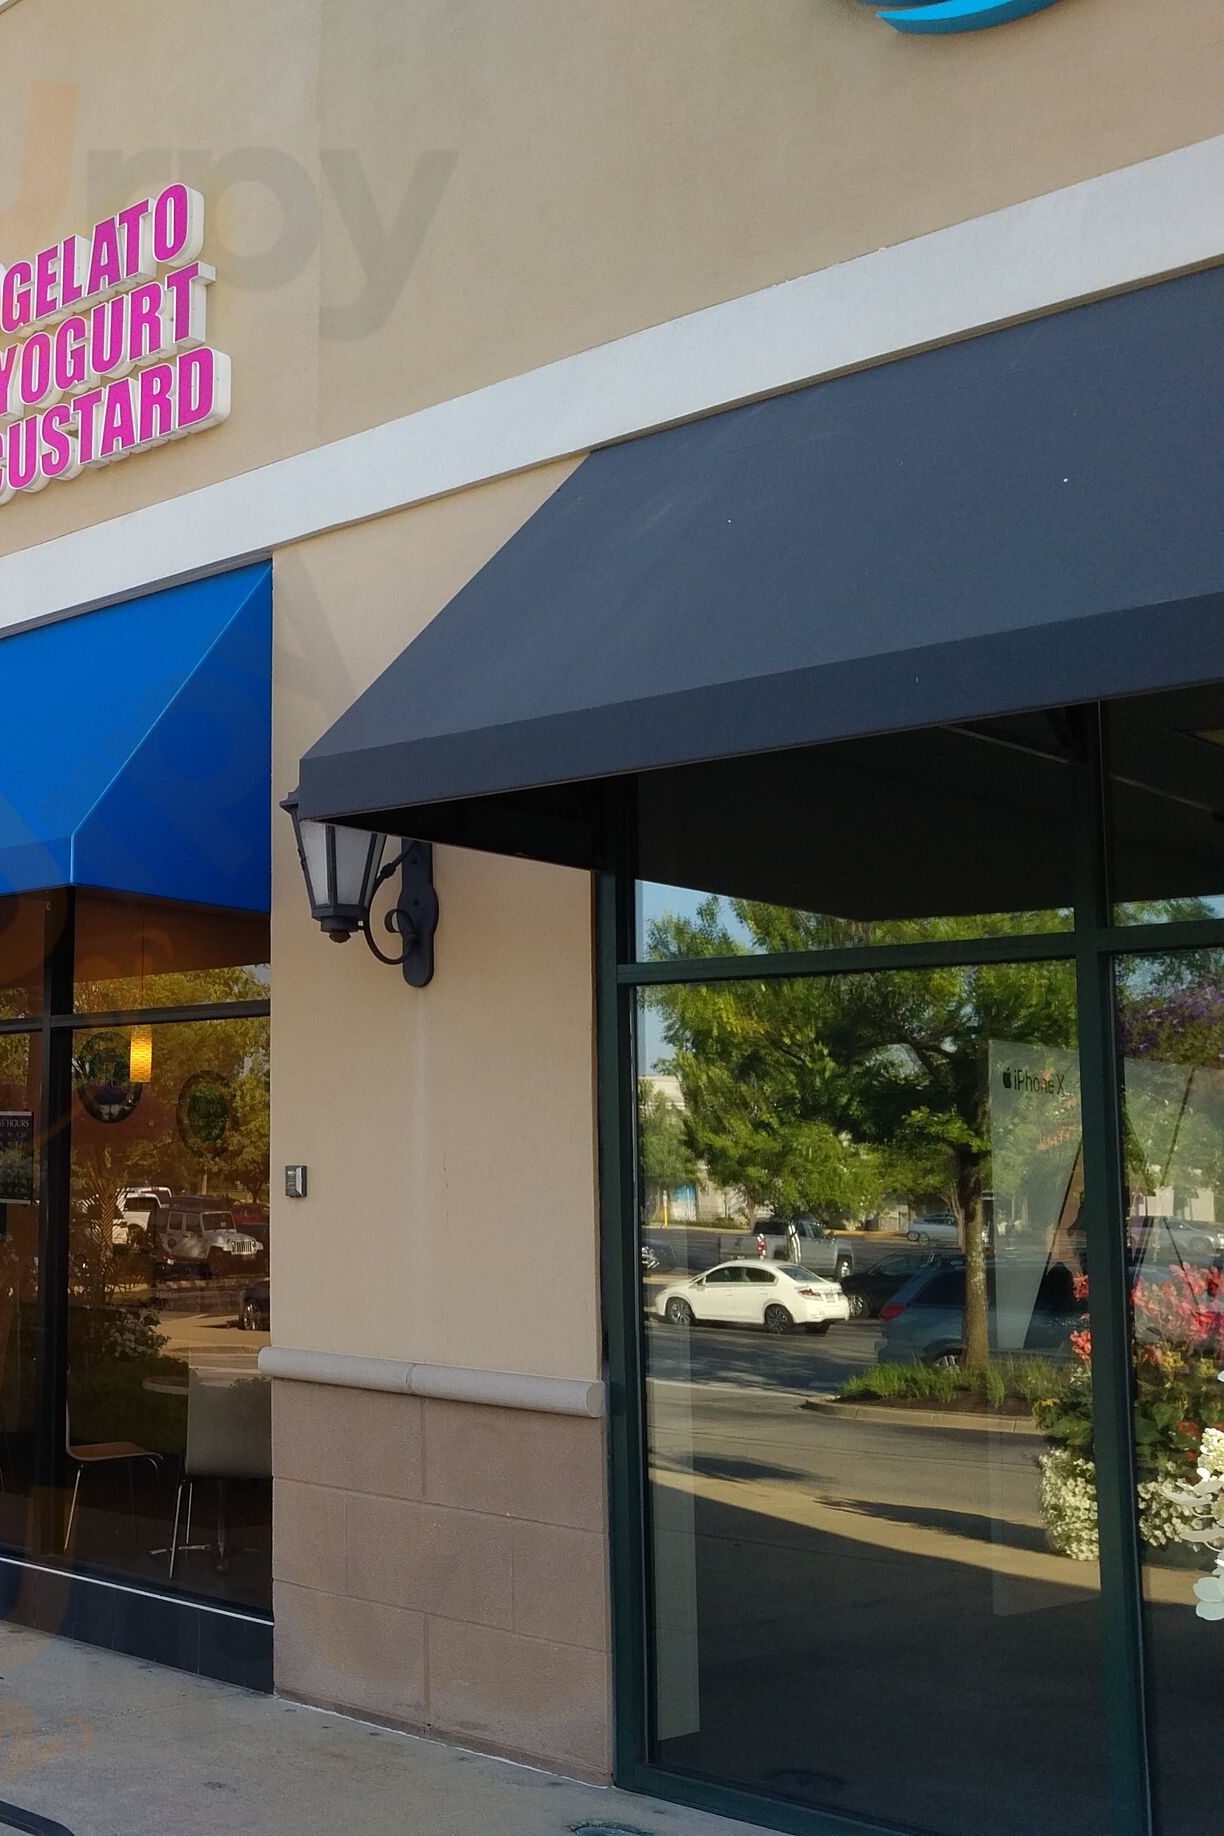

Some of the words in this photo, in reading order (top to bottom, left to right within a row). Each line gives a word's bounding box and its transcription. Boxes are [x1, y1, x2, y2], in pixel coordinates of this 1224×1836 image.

[0, 183, 194, 335] GELATO
[1014, 1069, 1055, 1095] iPhone
[1056, 1072, 1065, 1097] X
[6, 1119, 30, 1129] HOURS
